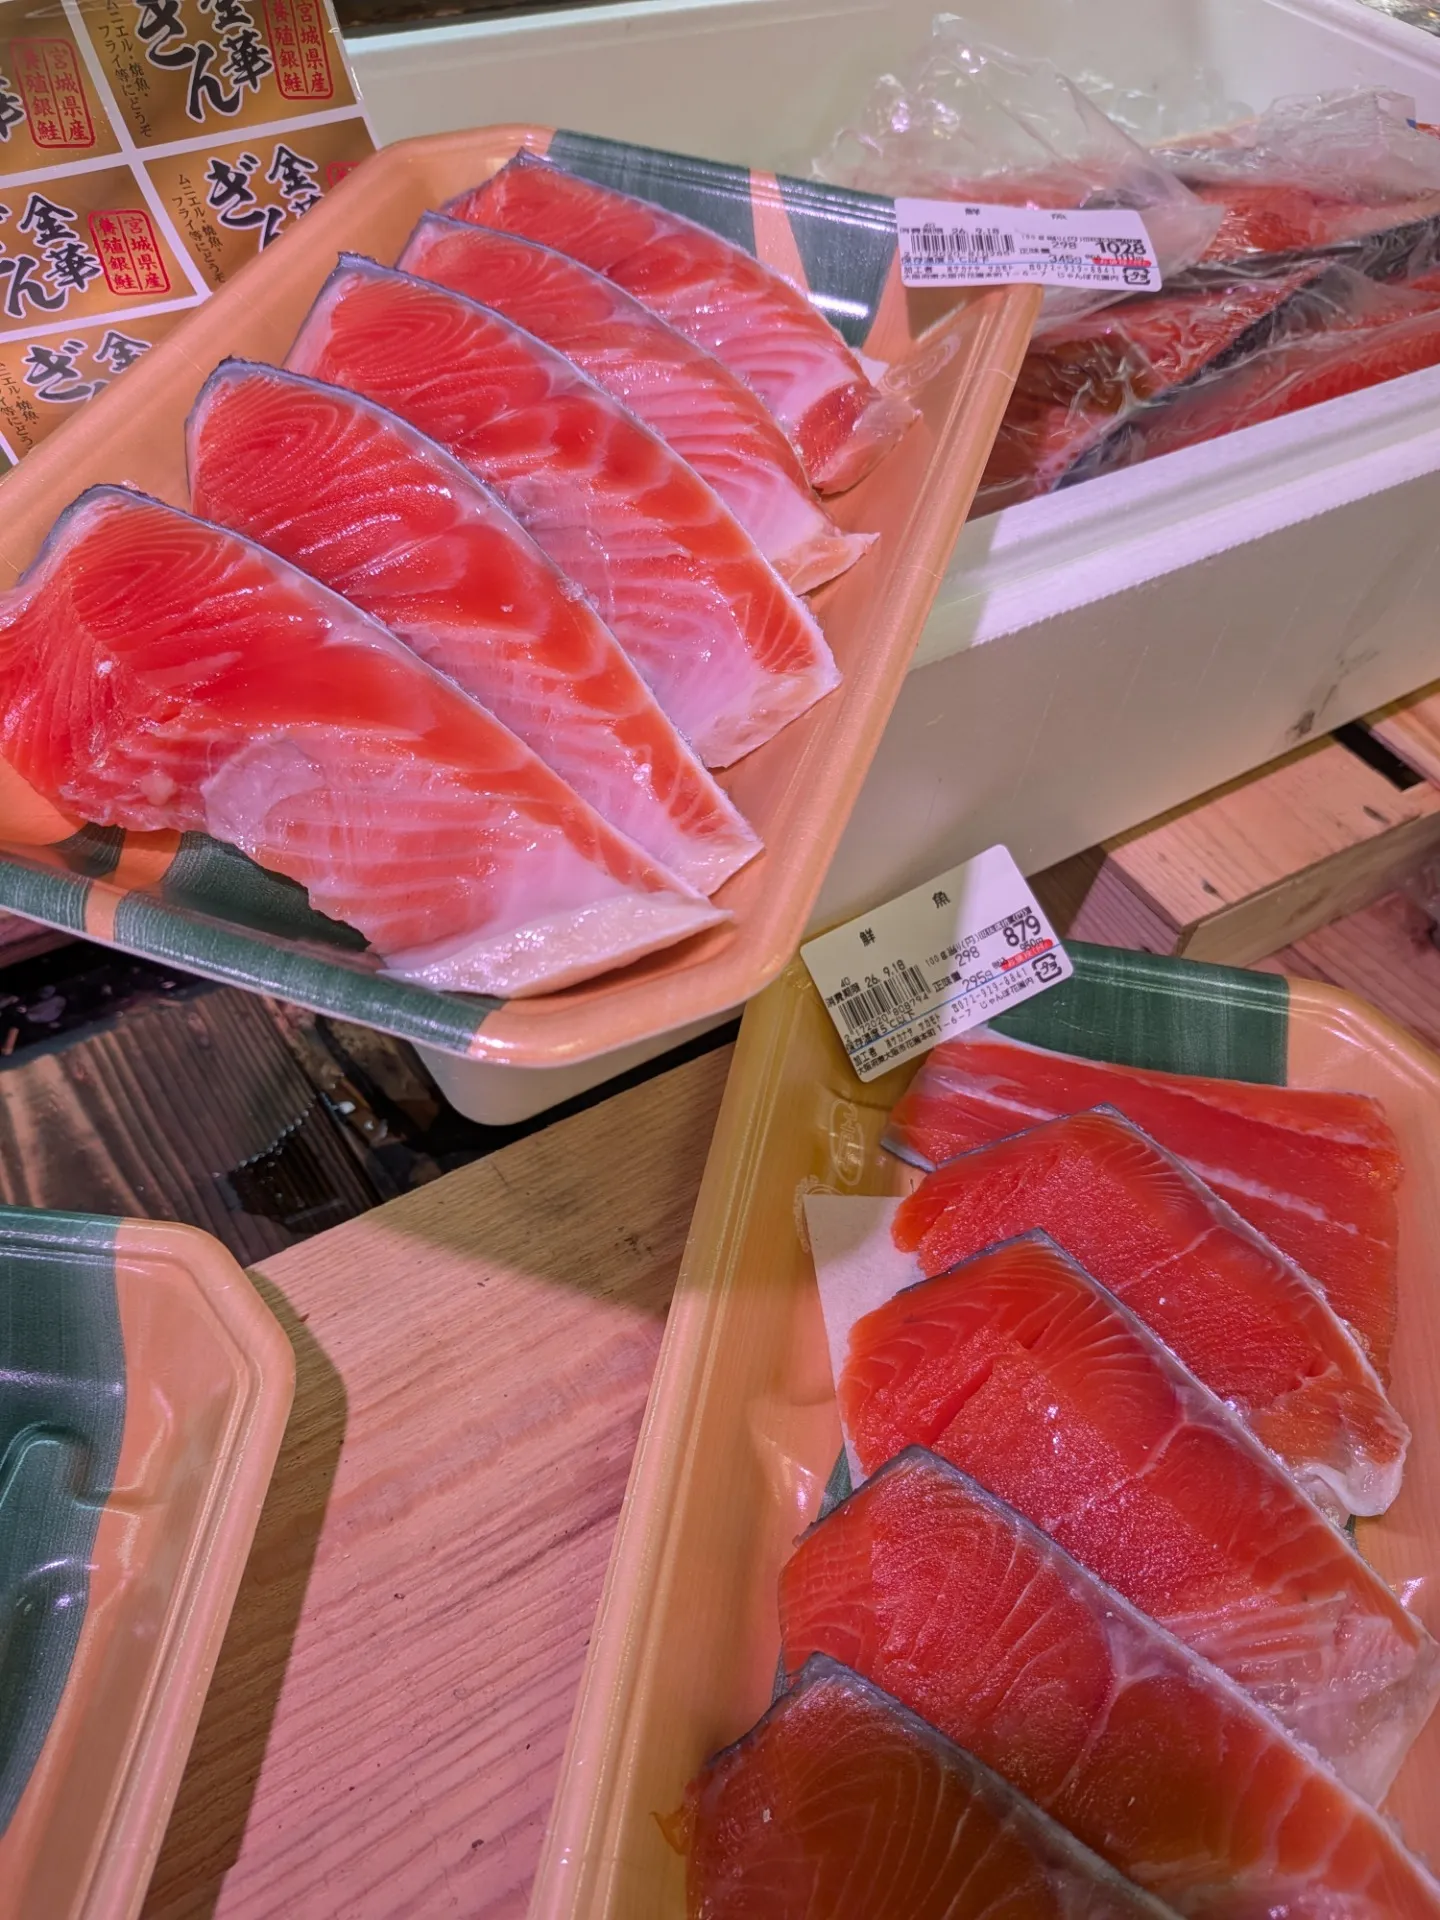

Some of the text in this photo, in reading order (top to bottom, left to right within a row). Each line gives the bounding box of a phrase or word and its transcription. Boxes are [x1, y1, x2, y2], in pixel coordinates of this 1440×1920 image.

[297, 0, 329, 92] 宮城県産
[49, 46, 90, 141] 宮城県産
[20, 194, 101, 289] 金華
[124, 216, 165, 289] 宮城県産
[1049, 254, 1082, 264] 345g
[1052, 240, 1146, 255] 298 1028
[859, 890, 951, 947] 鮮 魚
[1000, 912, 1044, 949] 879
[931, 966, 995, 993] 正味量 295g
[953, 944, 981, 968] 298
[823, 981, 862, 1008] 消費期限
[881, 957, 907, 979] 9.18
[840, 977, 851, 987] 40
[843, 991, 930, 1043] 2 172020 808794
